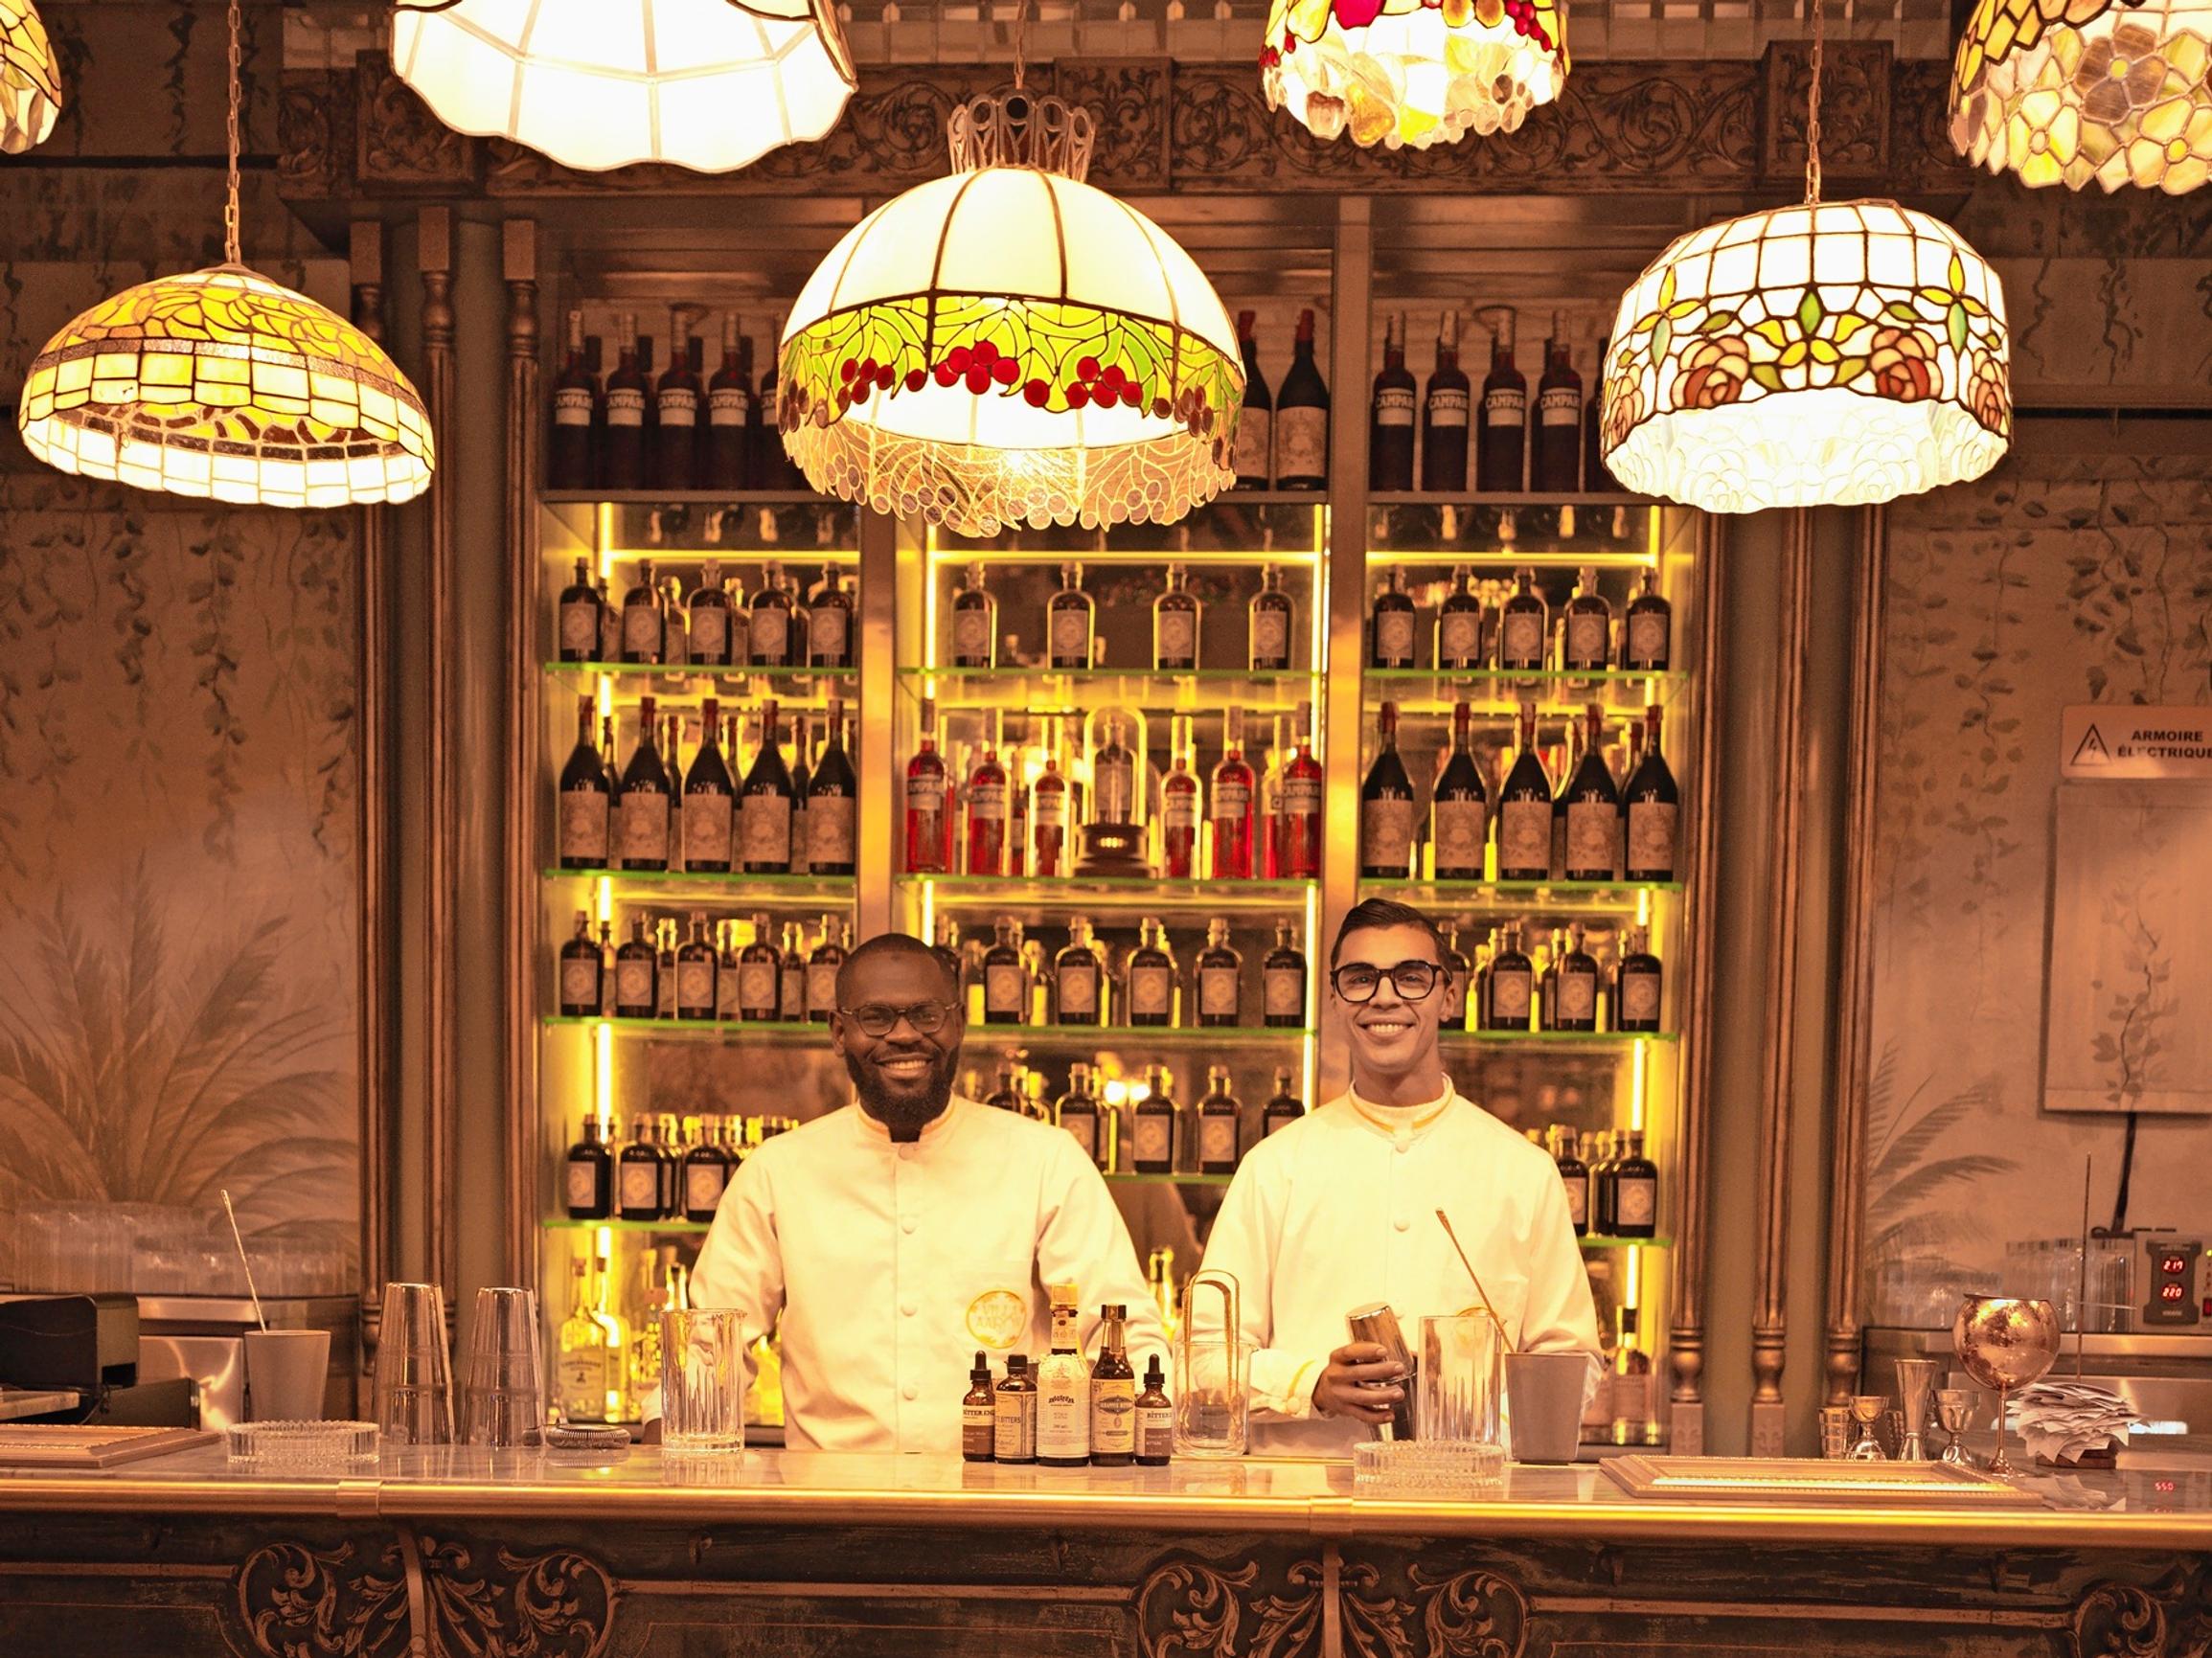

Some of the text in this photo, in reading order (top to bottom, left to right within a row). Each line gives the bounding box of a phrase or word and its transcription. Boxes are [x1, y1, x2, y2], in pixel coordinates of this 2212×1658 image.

[1376, 394, 1414, 409] CAMPAR
[1486, 395, 1524, 410] CAMPAR
[2132, 730, 2203, 741] ARMOIRE
[2162, 1287, 2182, 1297] 220
